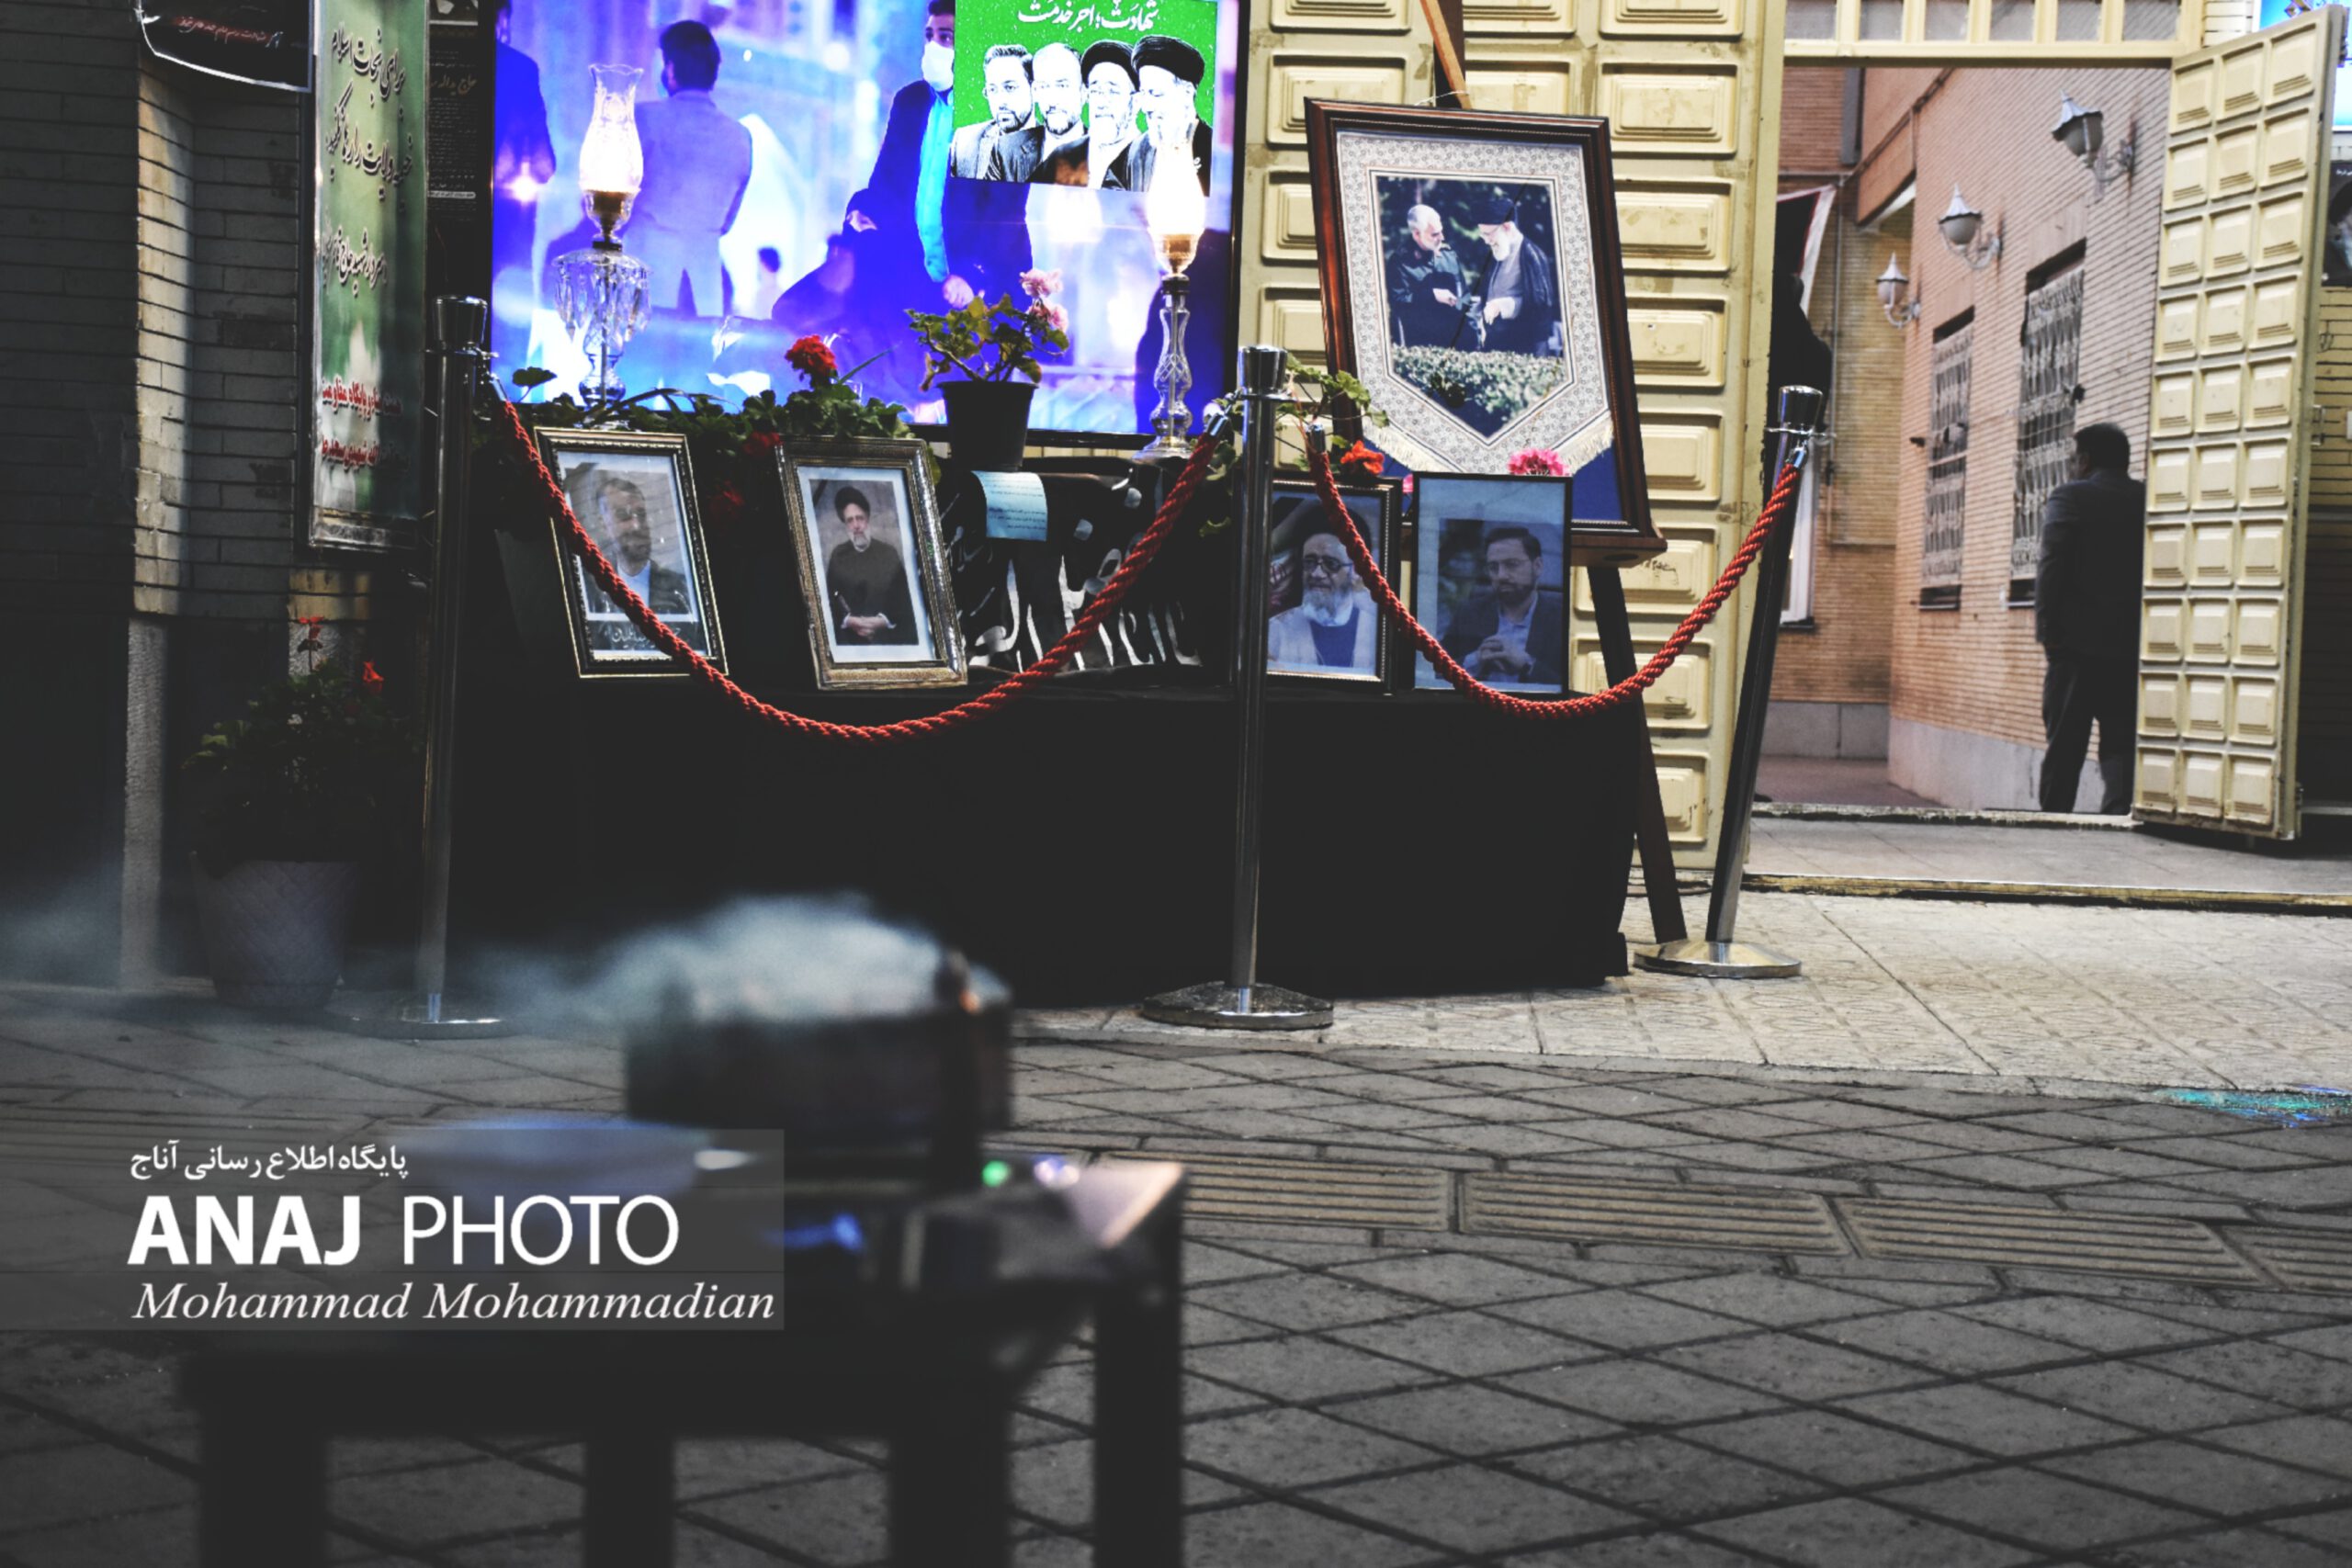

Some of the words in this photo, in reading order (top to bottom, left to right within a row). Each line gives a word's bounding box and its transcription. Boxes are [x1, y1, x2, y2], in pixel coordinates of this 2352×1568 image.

[1018, 0, 1073, 23] خدمت
[1068, 4, 1095, 33] اجر
[332, 21, 353, 64] اسلام
[362, 139, 393, 202] ولایت
